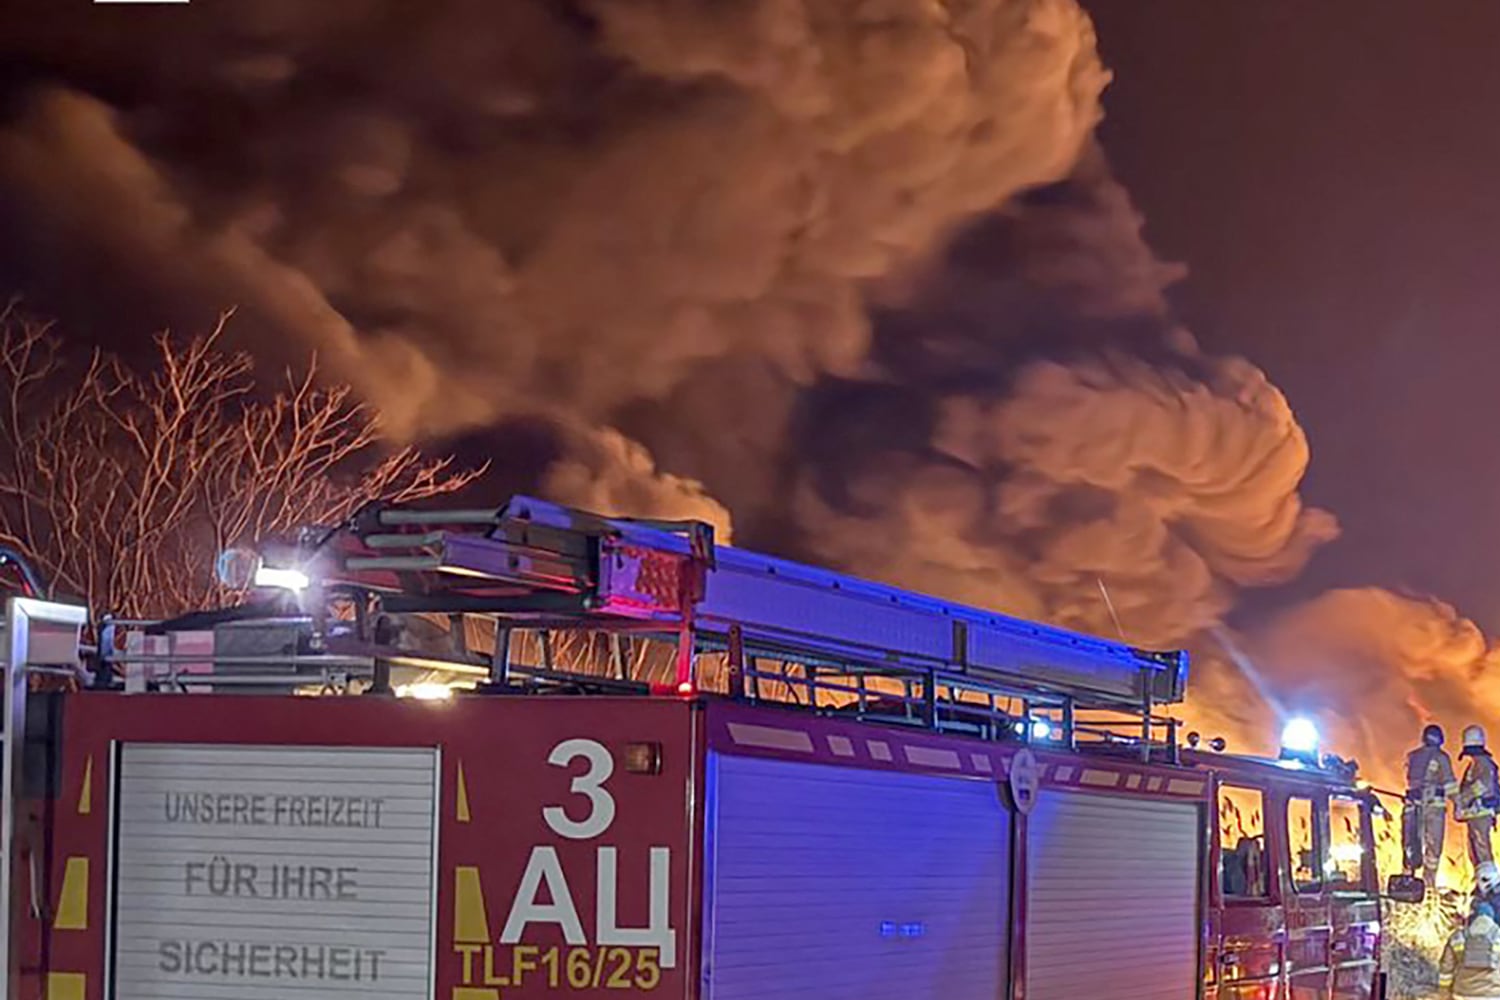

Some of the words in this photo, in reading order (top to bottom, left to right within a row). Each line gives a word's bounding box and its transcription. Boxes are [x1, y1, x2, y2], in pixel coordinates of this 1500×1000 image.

[165, 791, 267, 826] UNSERE
[274, 795, 384, 829] FREIZEIT
[542, 738, 616, 839] 3
[185, 855, 258, 896] FÜR
[272, 865, 358, 900] IHRE
[499, 846, 676, 968] АЦ
[159, 941, 387, 981] SICHERHEIT
